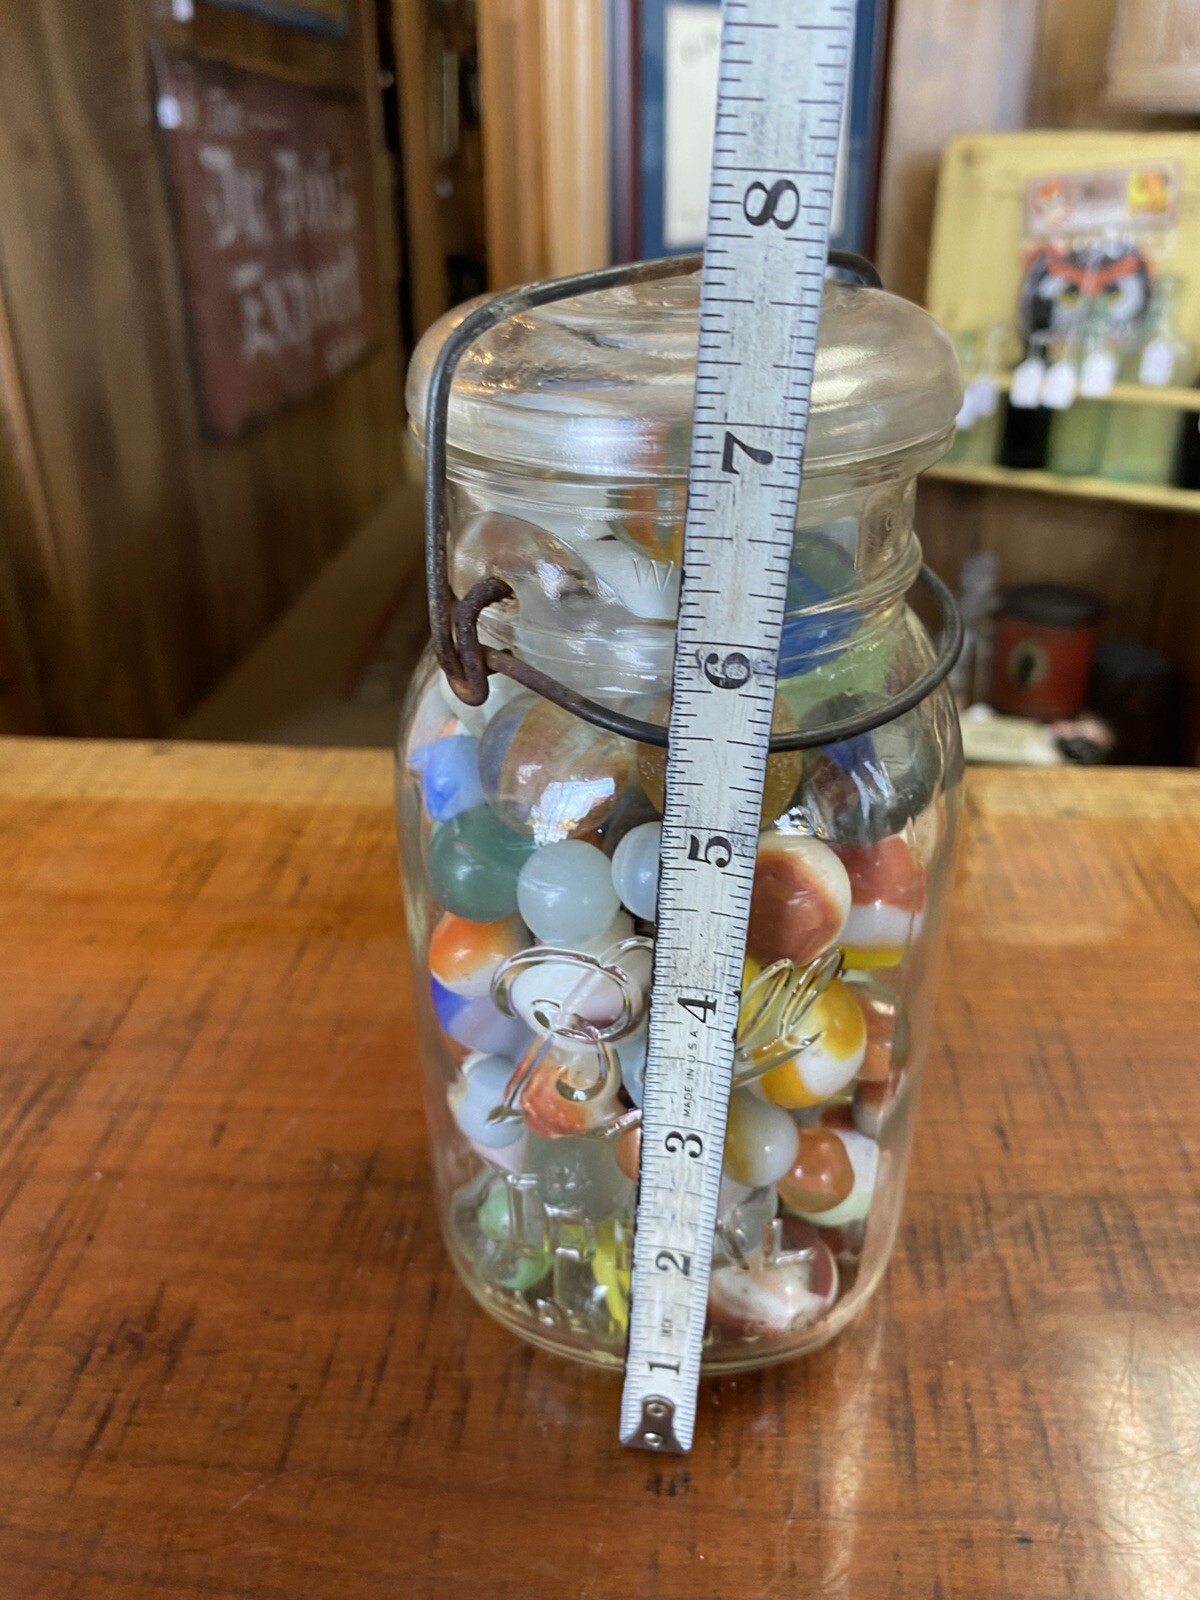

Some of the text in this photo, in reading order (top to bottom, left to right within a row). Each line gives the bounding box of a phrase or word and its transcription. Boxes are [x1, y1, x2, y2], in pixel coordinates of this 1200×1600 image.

[743, 179, 800, 230] 8
[722, 431, 774, 475] 7
[704, 652, 751, 690] 6
[687, 834, 733, 868] 5
[677, 994, 718, 1024] 4
[486, 935, 843, 1137] Bll
[686, 1068, 695, 1080] IN
[683, 1085, 694, 1118] MADE
[664, 1130, 703, 1159] 3
[655, 1250, 691, 1277] 2
[646, 1360, 681, 1376] 1
